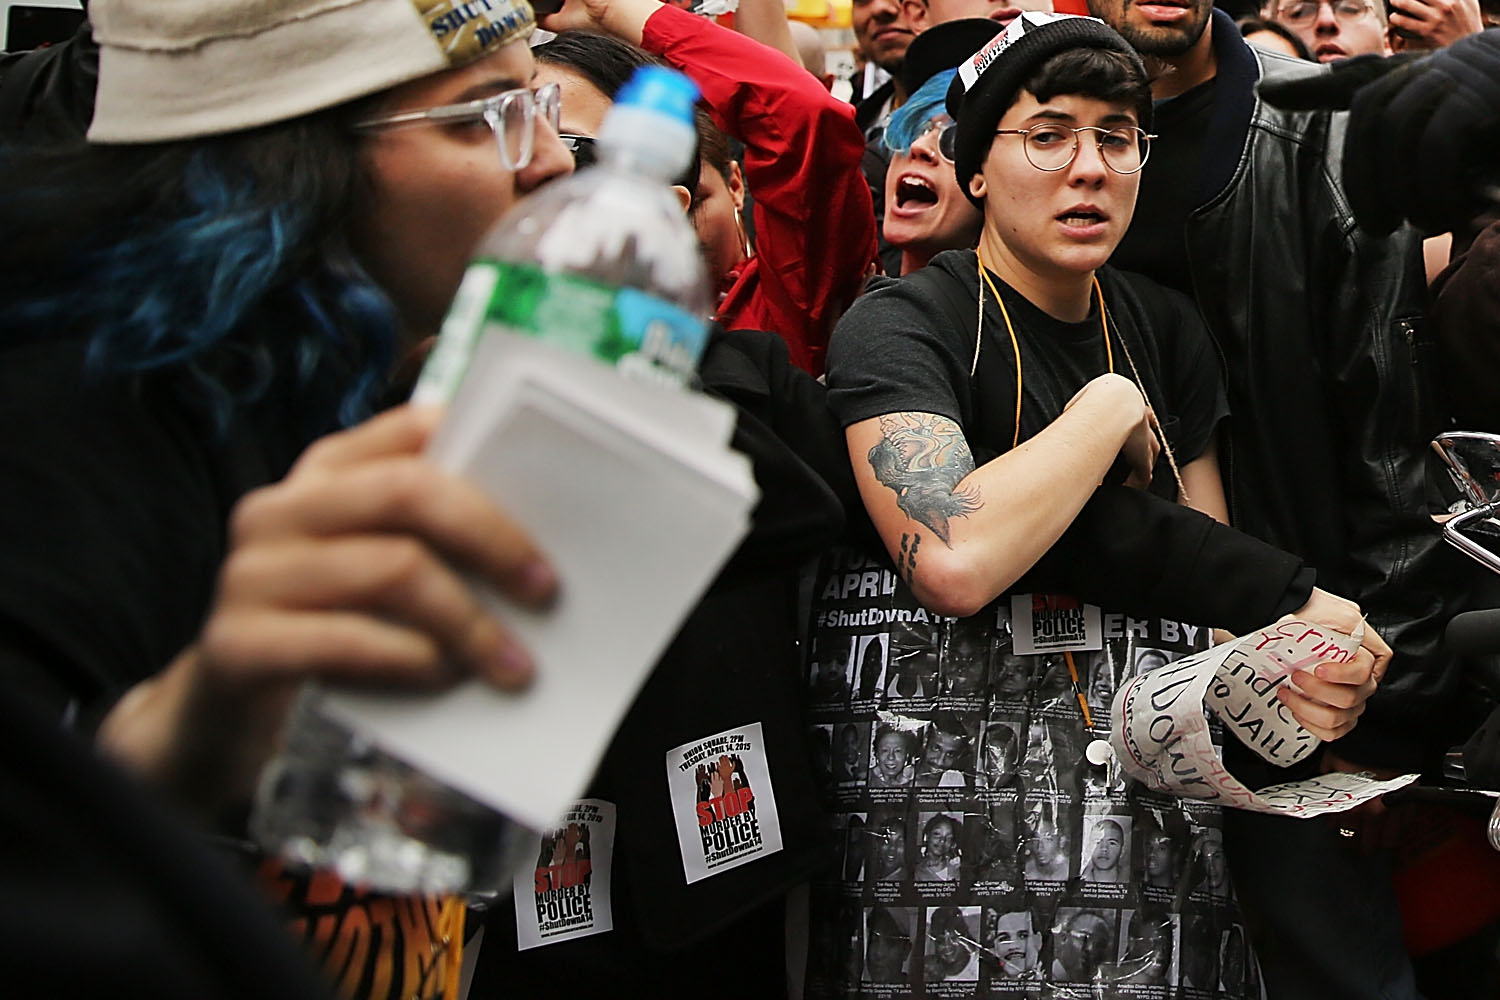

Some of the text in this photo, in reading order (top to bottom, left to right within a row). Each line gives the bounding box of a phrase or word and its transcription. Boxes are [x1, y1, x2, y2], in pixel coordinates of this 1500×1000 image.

[1033, 616, 1086, 637] POLICE
[1160, 617, 1199, 646] BY
[1277, 621, 1358, 664] Crim
[696, 787, 753, 827] STOP
[701, 809, 757, 837] MURDER BY
[703, 819, 761, 856] POLICE
[535, 859, 592, 893] STOP
[535, 882, 590, 905] MURDER BY
[537, 894, 592, 924] POLICE
